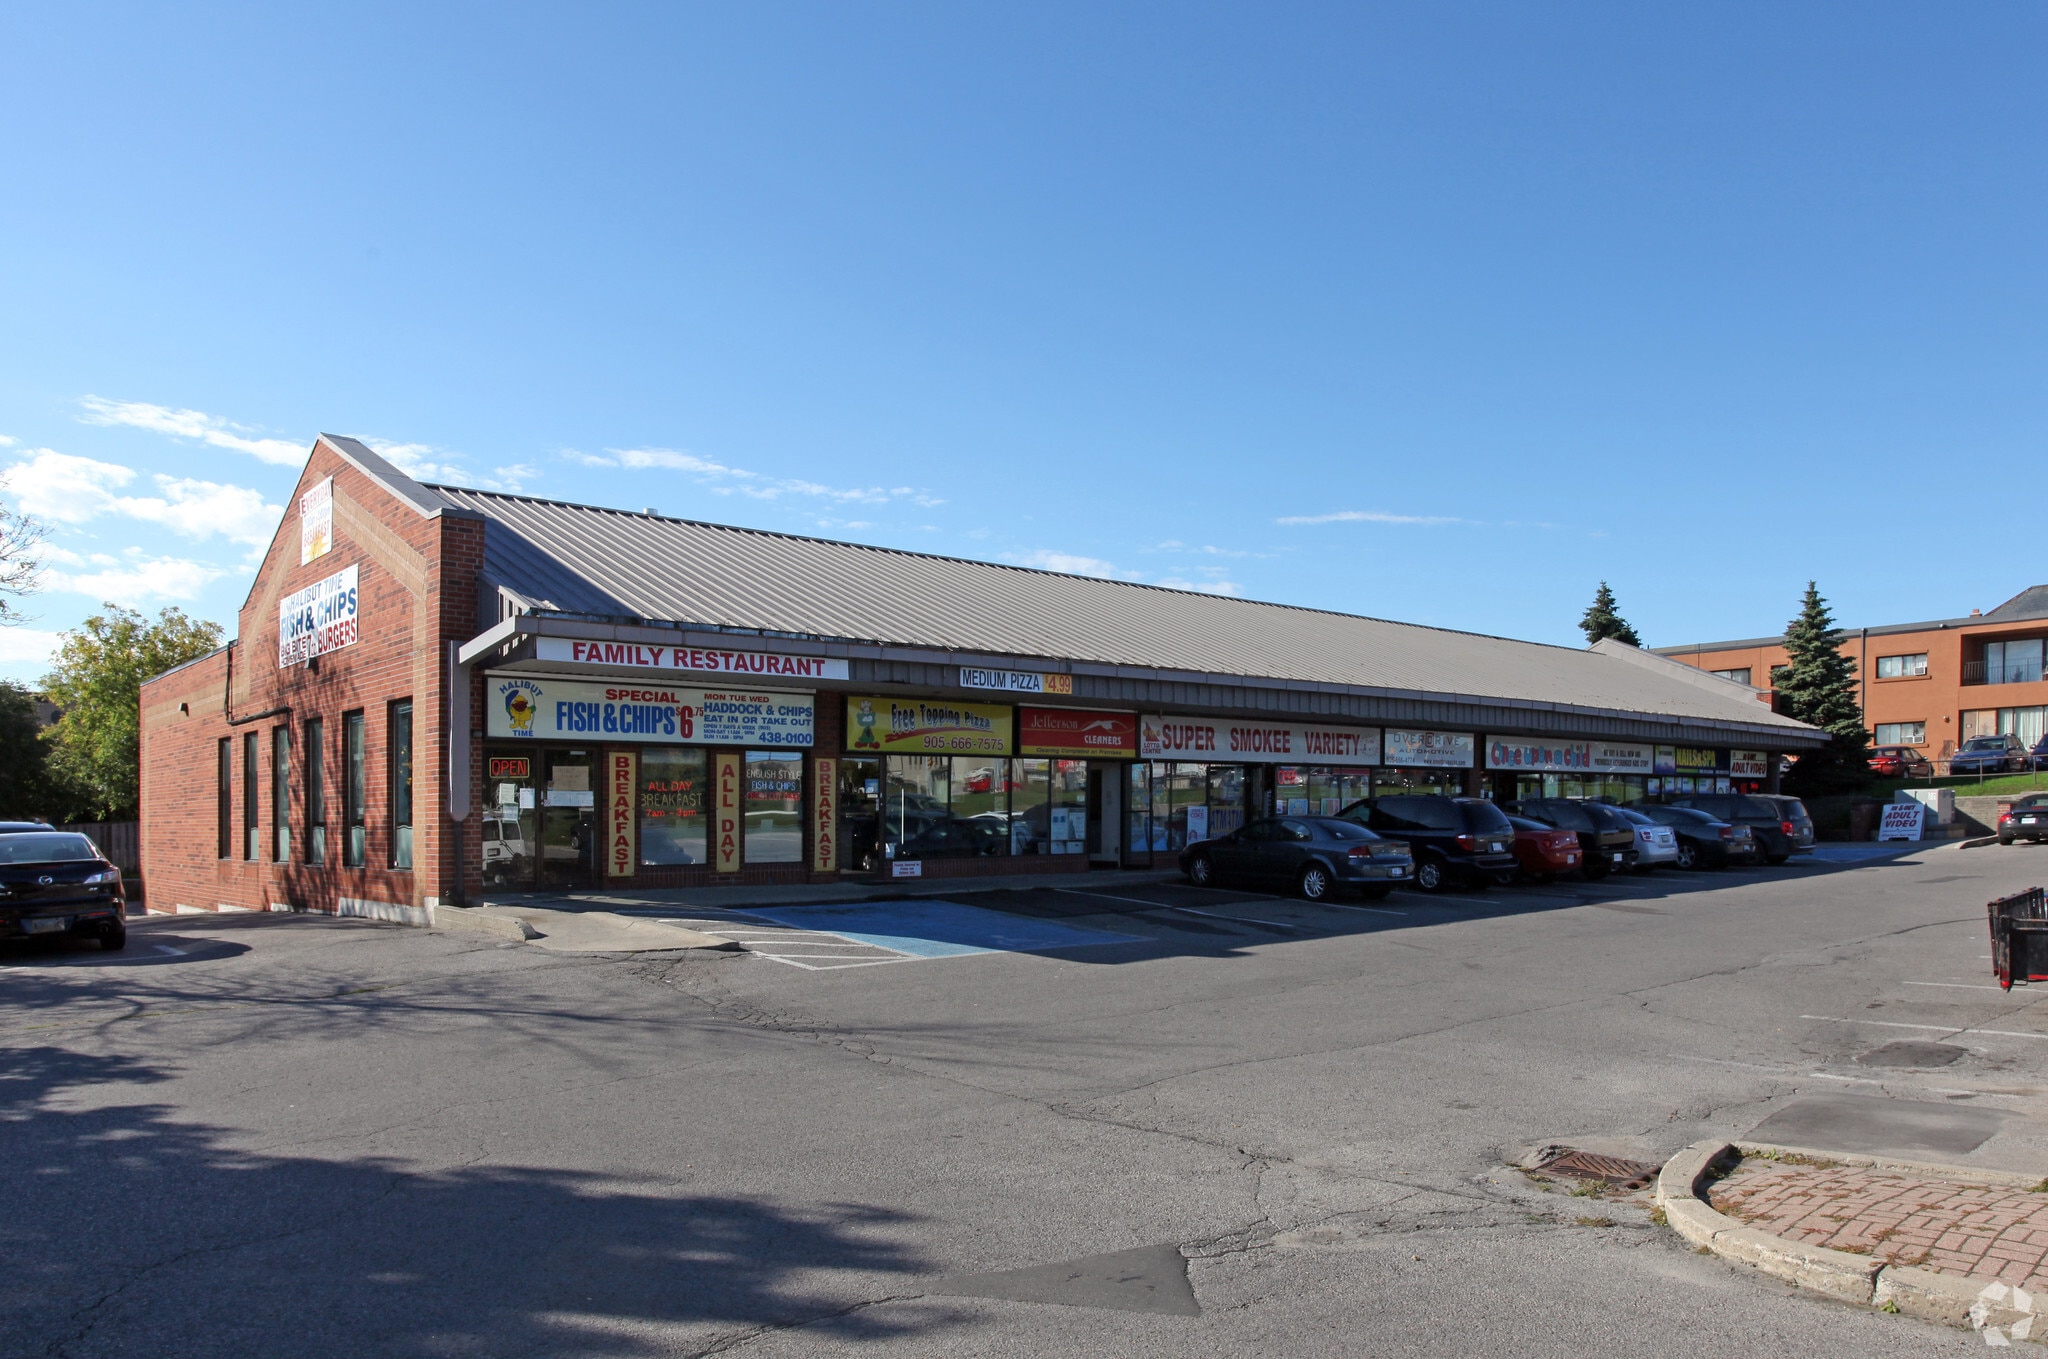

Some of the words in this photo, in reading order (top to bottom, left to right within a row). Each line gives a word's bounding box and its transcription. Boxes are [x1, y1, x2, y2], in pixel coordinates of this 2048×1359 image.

[290, 583, 321, 608] HALIBUT
[324, 573, 343, 595] TIME
[281, 609, 303, 642] FISH
[305, 605, 314, 632] &
[317, 587, 356, 627] CHIPS
[280, 643, 290, 657] BIG
[292, 636, 306, 652] BITE
[318, 617, 355, 653] BURGERS
[572, 641, 664, 666] FAMILY
[673, 649, 825, 677] RESTAURANT
[499, 680, 543, 697] HALIBUT
[962, 669, 1006, 688] MEDIUM
[1010, 673, 1040, 690] PIZZA
[1045, 675, 1071, 693] $4.99
[605, 688, 680, 704] SPECIAL
[556, 701, 600, 732] FISH
[620, 704, 676, 735] CHIPS
[704, 702, 762, 716] HADDOCK
[766, 705, 774, 716] &
[778, 706, 812, 718] CHIPS
[891, 703, 916, 733] Free
[920, 703, 960, 728] Topping
[964, 711, 991, 729] Pizza
[728, 716, 738, 724] IN
[742, 716, 758, 724] OR
[761, 717, 788, 726] TAKE
[1031, 714, 1078, 729] Jefferson
[512, 729, 534, 737] TIME
[758, 732, 812, 744] 438-0100
[1084, 735, 1122, 745] CLEANERS
[1162, 724, 1216, 750] SUPER
[1230, 727, 1291, 753] SMOKEE
[1304, 731, 1361, 756] VARIETY
[1393, 732, 1460, 748] OVERDRIVE
[924, 736, 1004, 750] 905-666-7575
[1491, 741, 1521, 767] Once
[1524, 746, 1553, 766] upon
[1554, 749, 1562, 765] a
[1564, 743, 1590, 768] child
[491, 760, 527, 776] OPEN
[746, 769, 777, 779] ENGLISH
[779, 769, 801, 780] STYLE
[1732, 761, 1749, 773] ADULT
[1750, 762, 1766, 774] VIDEO
[648, 781, 667, 791] ALL
[671, 781, 693, 791] DAY
[721, 764, 735, 808] ALL
[752, 780, 767, 790] FISH
[768, 781, 774, 790] &
[776, 781, 796, 791] CHIPS
[640, 793, 702, 807] BREAKFAST
[614, 757, 630, 873] BREAKFAST
[819, 761, 832, 868] BREAKFAST
[1885, 811, 1920, 820] ADULT
[1885, 820, 1917, 828] VIDEO
[721, 819, 735, 863] DAY
